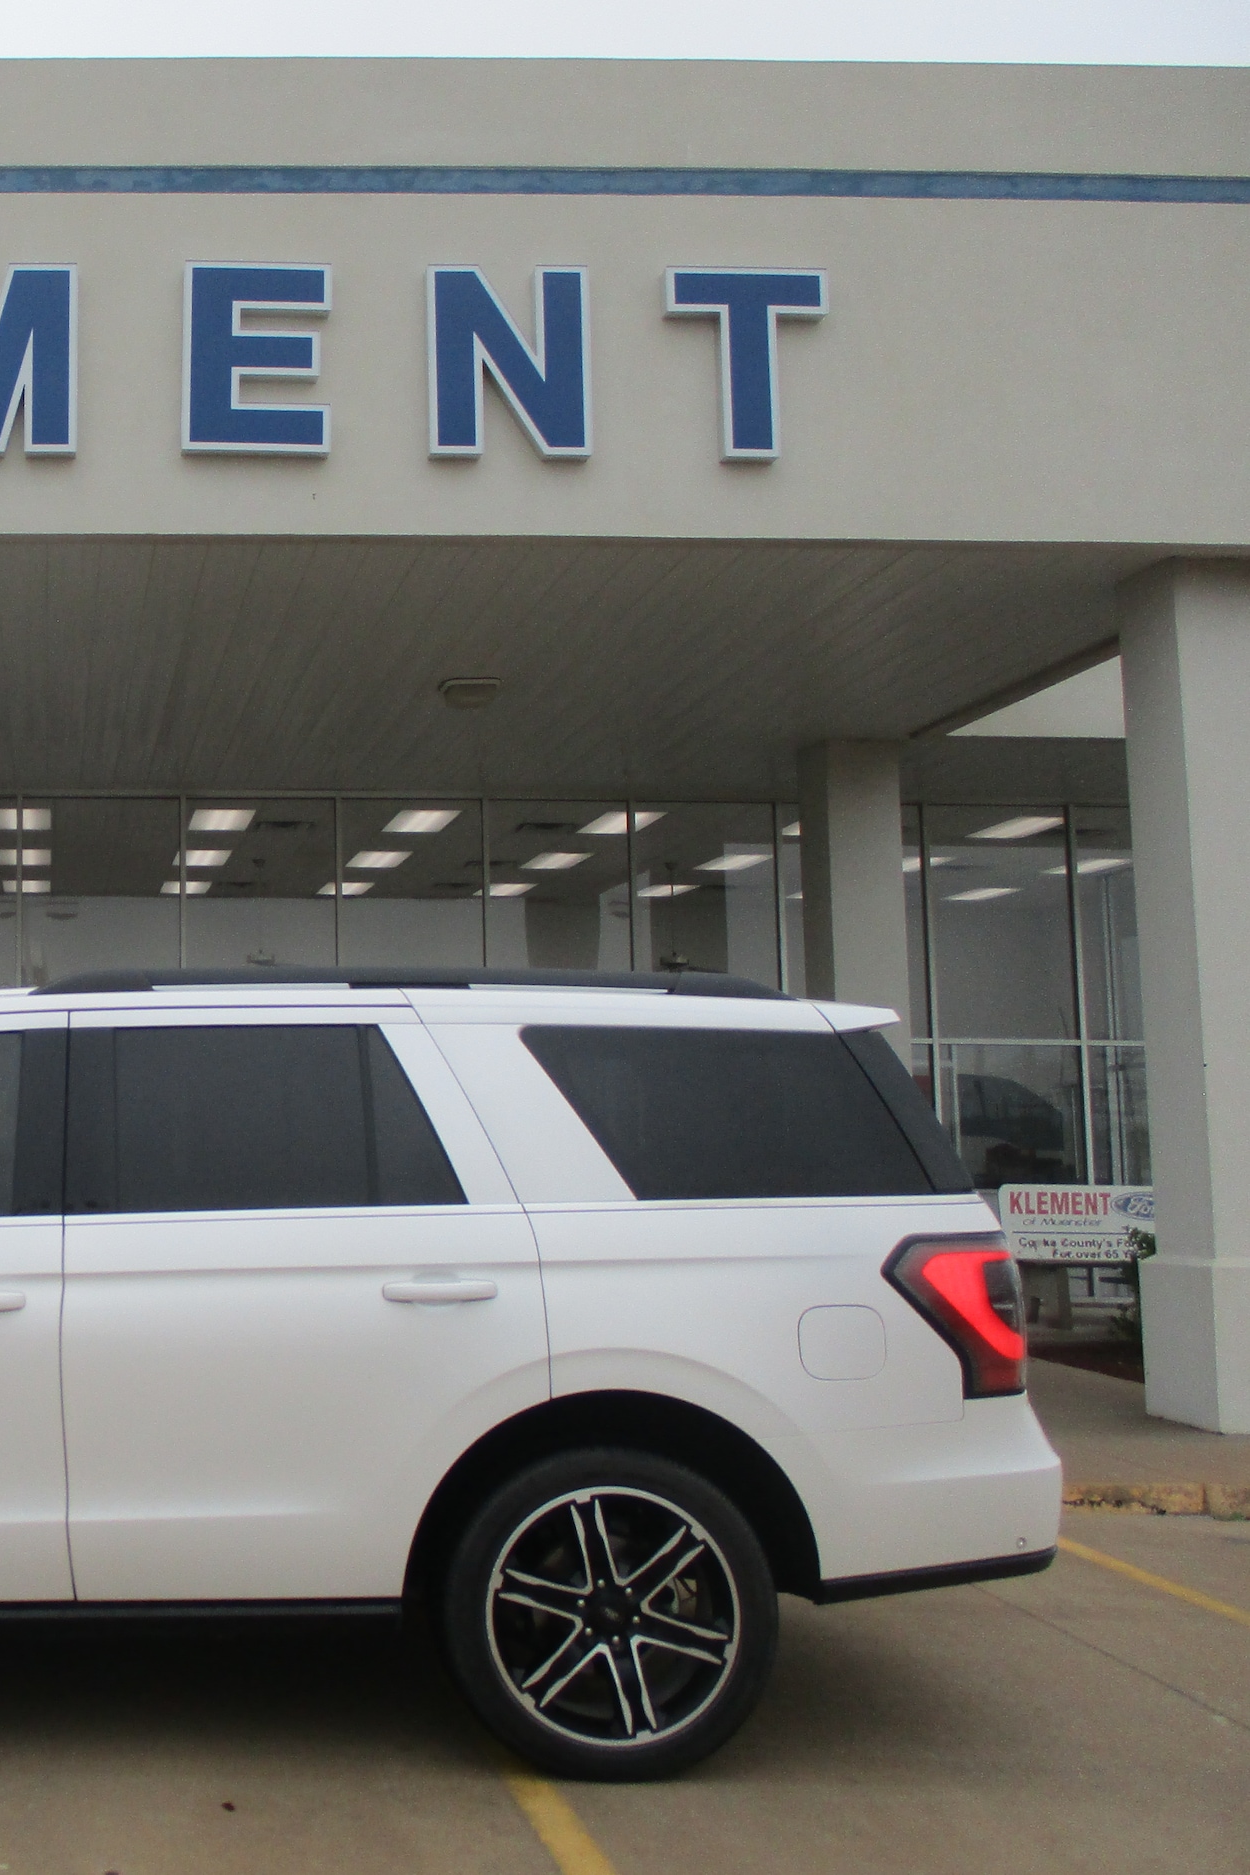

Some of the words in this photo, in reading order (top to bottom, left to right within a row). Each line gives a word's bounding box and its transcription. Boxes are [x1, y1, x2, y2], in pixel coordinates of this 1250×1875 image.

[1009, 1191, 1111, 1215] KLEMENT
[1018, 1236, 1057, 1249] Coke
[1060, 1237, 1113, 1250] County's
